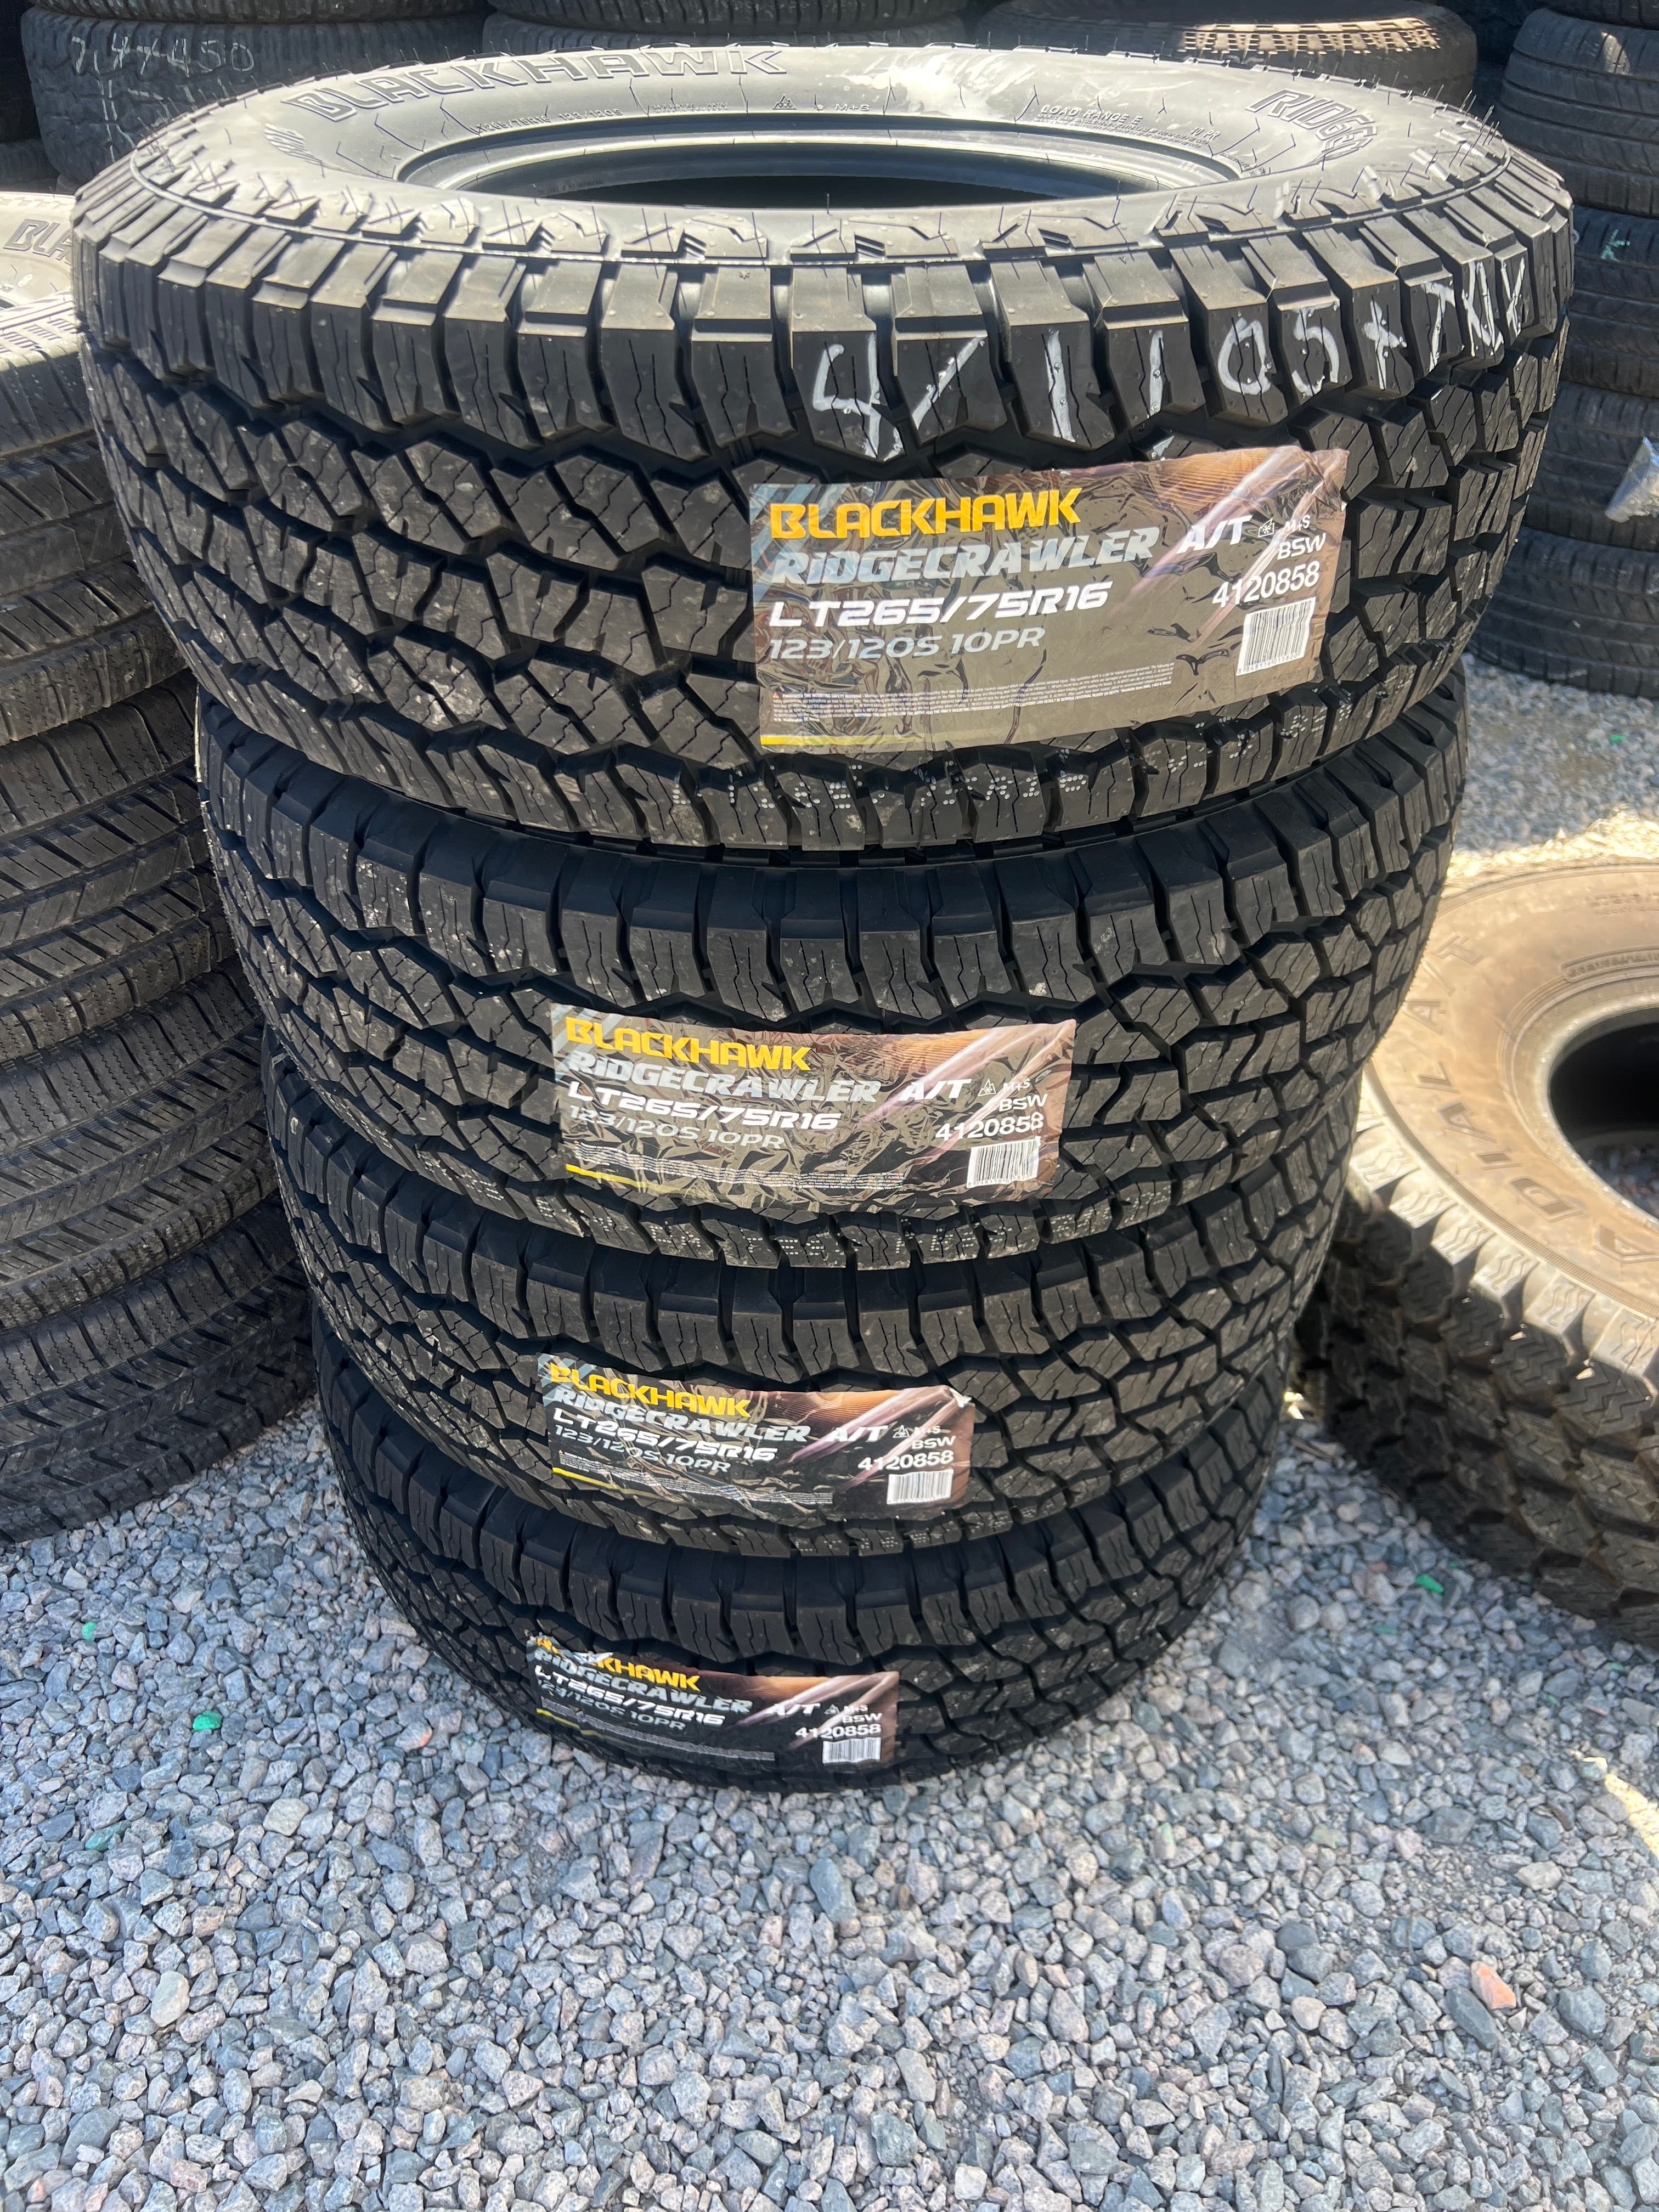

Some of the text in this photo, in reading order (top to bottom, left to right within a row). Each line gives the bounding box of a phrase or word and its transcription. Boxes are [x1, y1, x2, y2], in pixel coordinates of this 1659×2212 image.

[280, 50, 788, 122] BLACKHAWK
[558, 108, 624, 121] 123/120S
[1040, 104, 1143, 126] LOAD RANGE E
[1203, 129, 1221, 140] PR
[1245, 88, 1378, 161] RIDGE
[3, 218, 72, 266] BLA
[770, 488, 1083, 539] BLACKHAWK
[771, 526, 1160, 585] RIDGECRAWLER
[1176, 515, 1253, 554] A/T
[1277, 533, 1327, 560] BSW
[769, 580, 1113, 628] LT265/75R16
[1212, 561, 1320, 608] 4120858
[769, 627, 1046, 659] 123/120S 10PR
[565, 1016, 811, 1071] BLACKHAWK
[568, 1050, 882, 1103] RIDGECRAWLER
[898, 1079, 972, 1102] A/T
[567, 1081, 842, 1130] LT265/75R16
[569, 1104, 786, 1149] 123/120S 10PR
[935, 1111, 1044, 1141] 4120858
[998, 1093, 1048, 1113] BSW
[550, 1362, 752, 1418] BLACKHAWK
[552, 1387, 811, 1442] RIDGECRAWLER
[825, 1425, 889, 1442] A/T
[553, 1407, 778, 1462] LT265/75R16
[554, 1423, 731, 1473] 123/120S 10PR
[857, 1450, 954, 1470] 4120858
[912, 1435, 956, 1450] BSW
[534, 1648, 753, 1713] RIDGECRAWLER
[766, 1702, 821, 1716] A/T
[630, 1711, 686, 1730] 10PR
[795, 1723, 882, 1739] 4120858
[842, 1712, 883, 1723] BSW
